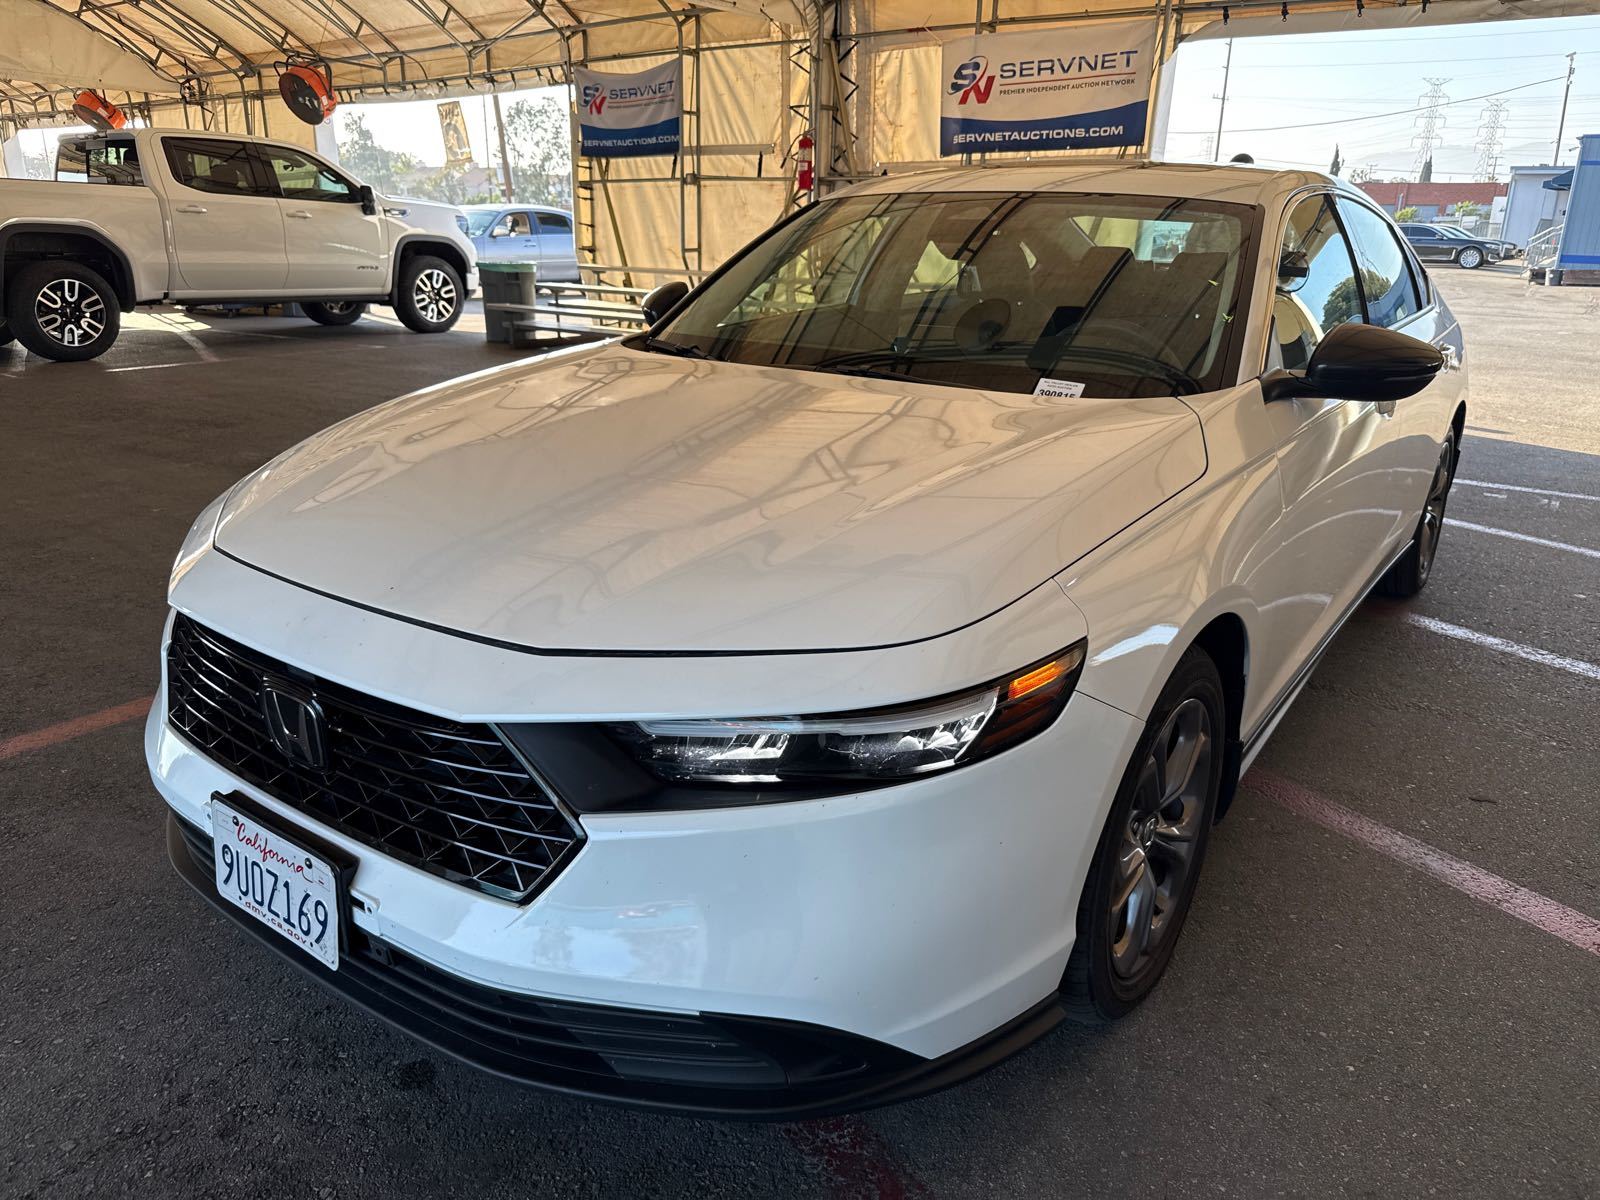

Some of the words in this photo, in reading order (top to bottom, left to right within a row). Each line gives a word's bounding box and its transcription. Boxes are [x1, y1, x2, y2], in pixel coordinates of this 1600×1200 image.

[1000, 50, 1138, 79] SERVNET
[609, 81, 674, 100] SERVNET
[1026, 84, 1070, 93] INDEPENDENT
[1071, 81, 1100, 89] AUCTION
[1101, 78, 1135, 87] NETWORK
[583, 136, 680, 147] SERVNETAUCTIONS.COM
[953, 125, 1124, 144] SERVNETAUCTIONS.COM
[237, 822, 312, 880] California
[245, 900, 307, 945] dmv.ca.gov
